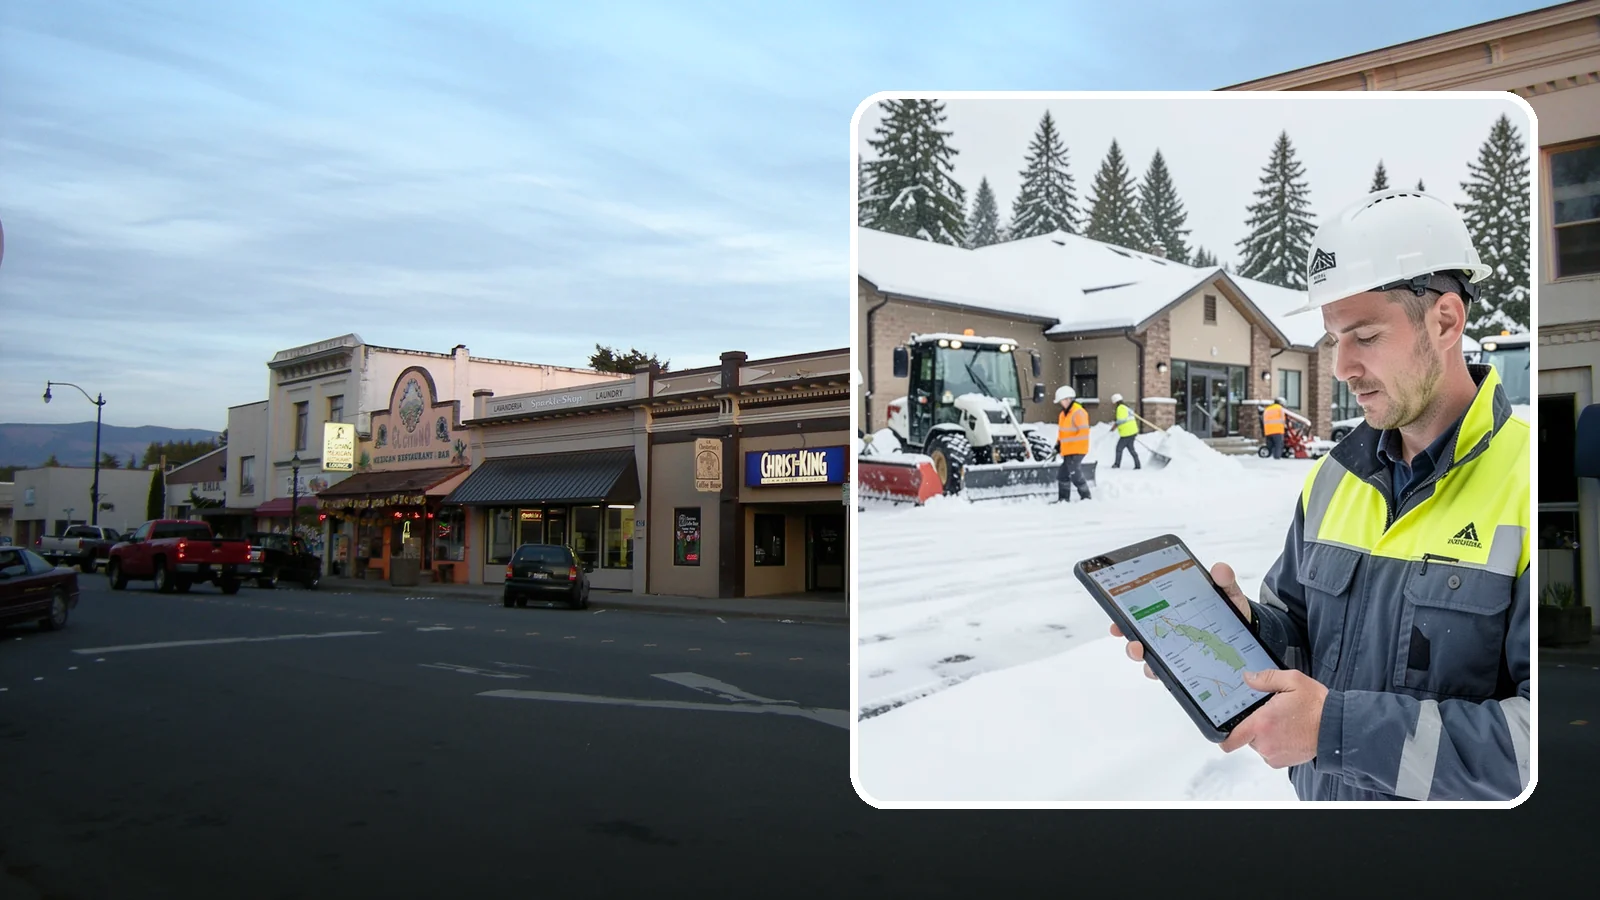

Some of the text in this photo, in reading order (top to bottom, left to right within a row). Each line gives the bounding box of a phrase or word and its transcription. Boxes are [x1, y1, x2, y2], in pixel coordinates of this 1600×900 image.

[493, 402, 523, 412] LAVANDERIA
[561, 394, 583, 405] Shop
[595, 389, 624, 400] LAUNDRY
[374, 454, 396, 463] MEXICAN
[397, 451, 433, 462] RESTAURANT
[438, 450, 450, 459] BAR
[799, 449, 827, 476] KING
